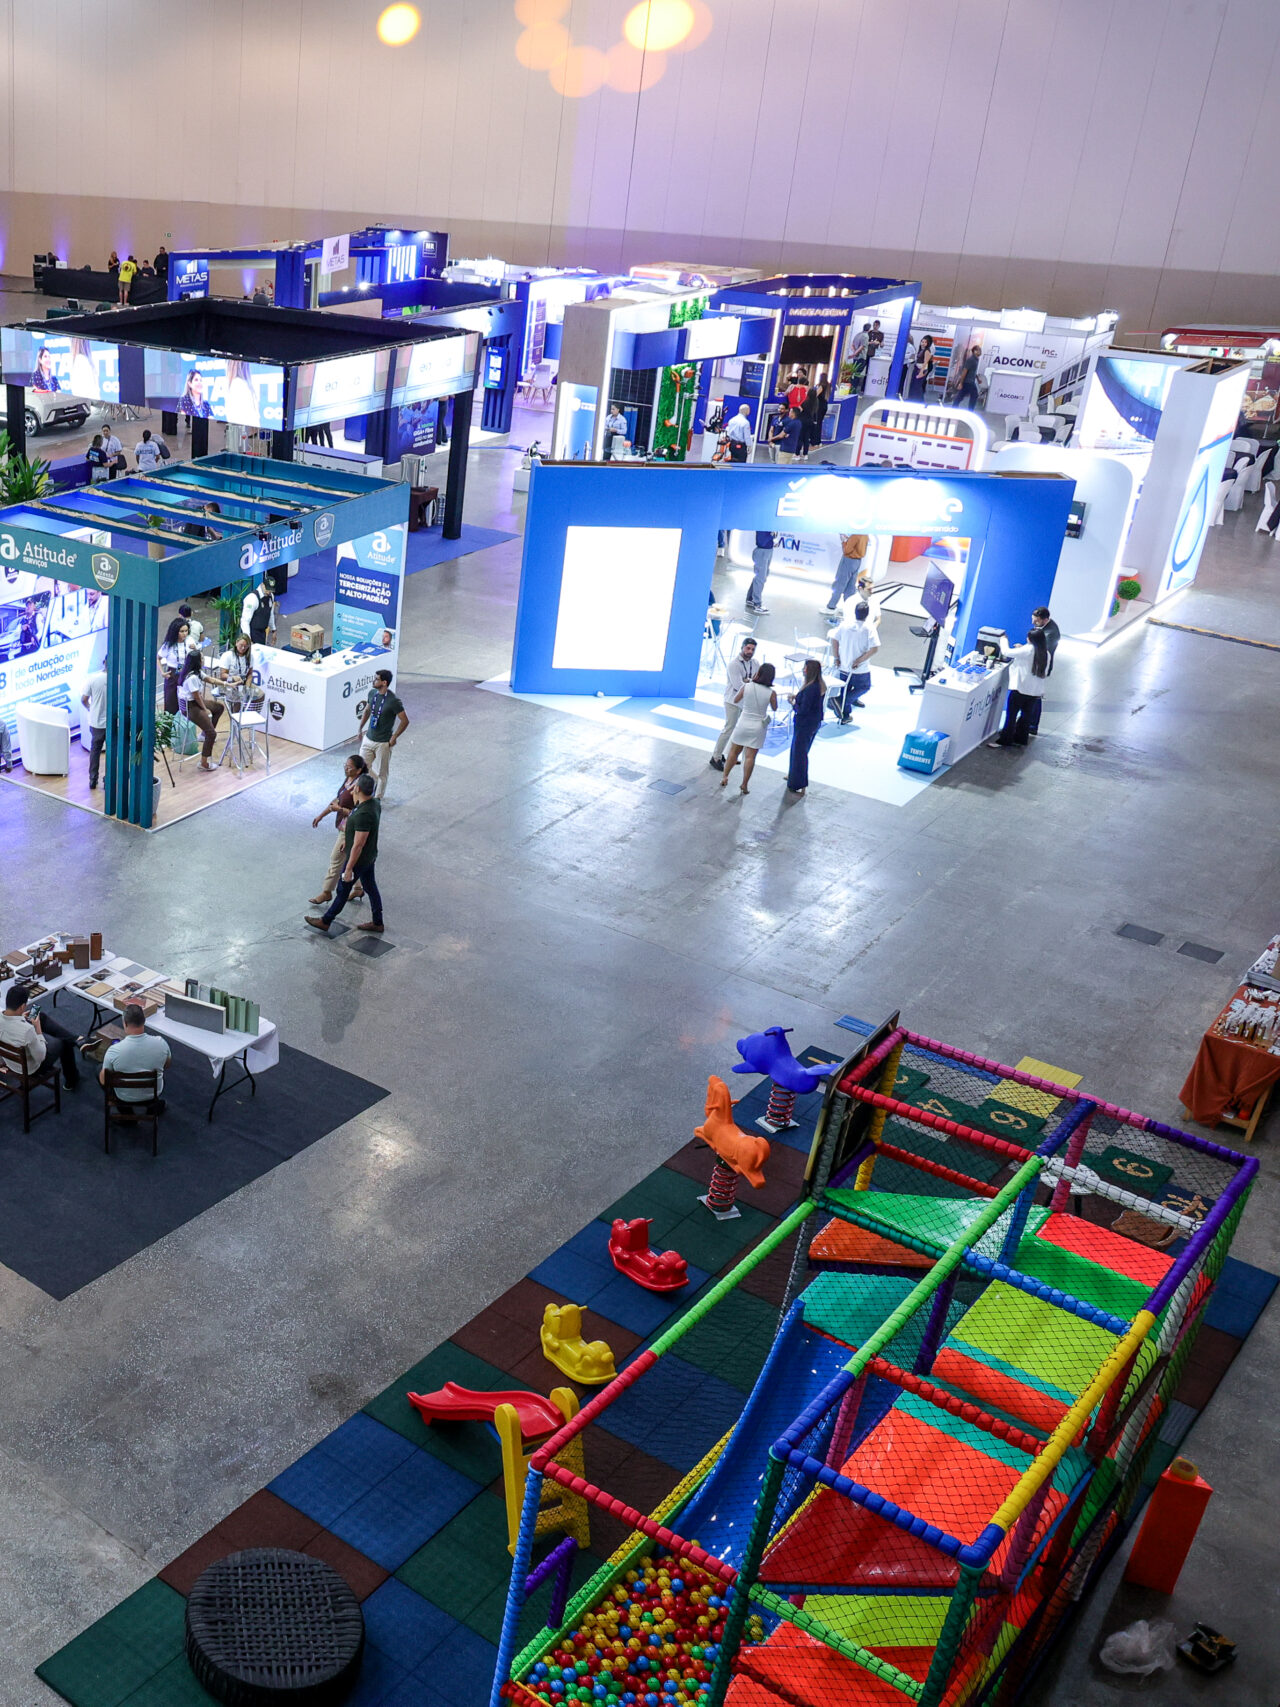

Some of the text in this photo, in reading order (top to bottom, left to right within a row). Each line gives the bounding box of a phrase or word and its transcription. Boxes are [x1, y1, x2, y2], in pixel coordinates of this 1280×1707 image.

[176, 272, 208, 285] METAS
[23, 541, 76, 568] Atitude
[23, 557, 48, 568] SERVIÇOS
[339, 579, 391, 597] TERCEIRIZAÇÃO
[345, 589, 362, 600] ALTO
[362, 593, 389, 605] PADRÃO
[28, 655, 65, 674] atuação
[36, 664, 74, 683] Nordeste
[267, 675, 307, 694] Atitude
[355, 675, 374, 689] Atitu
